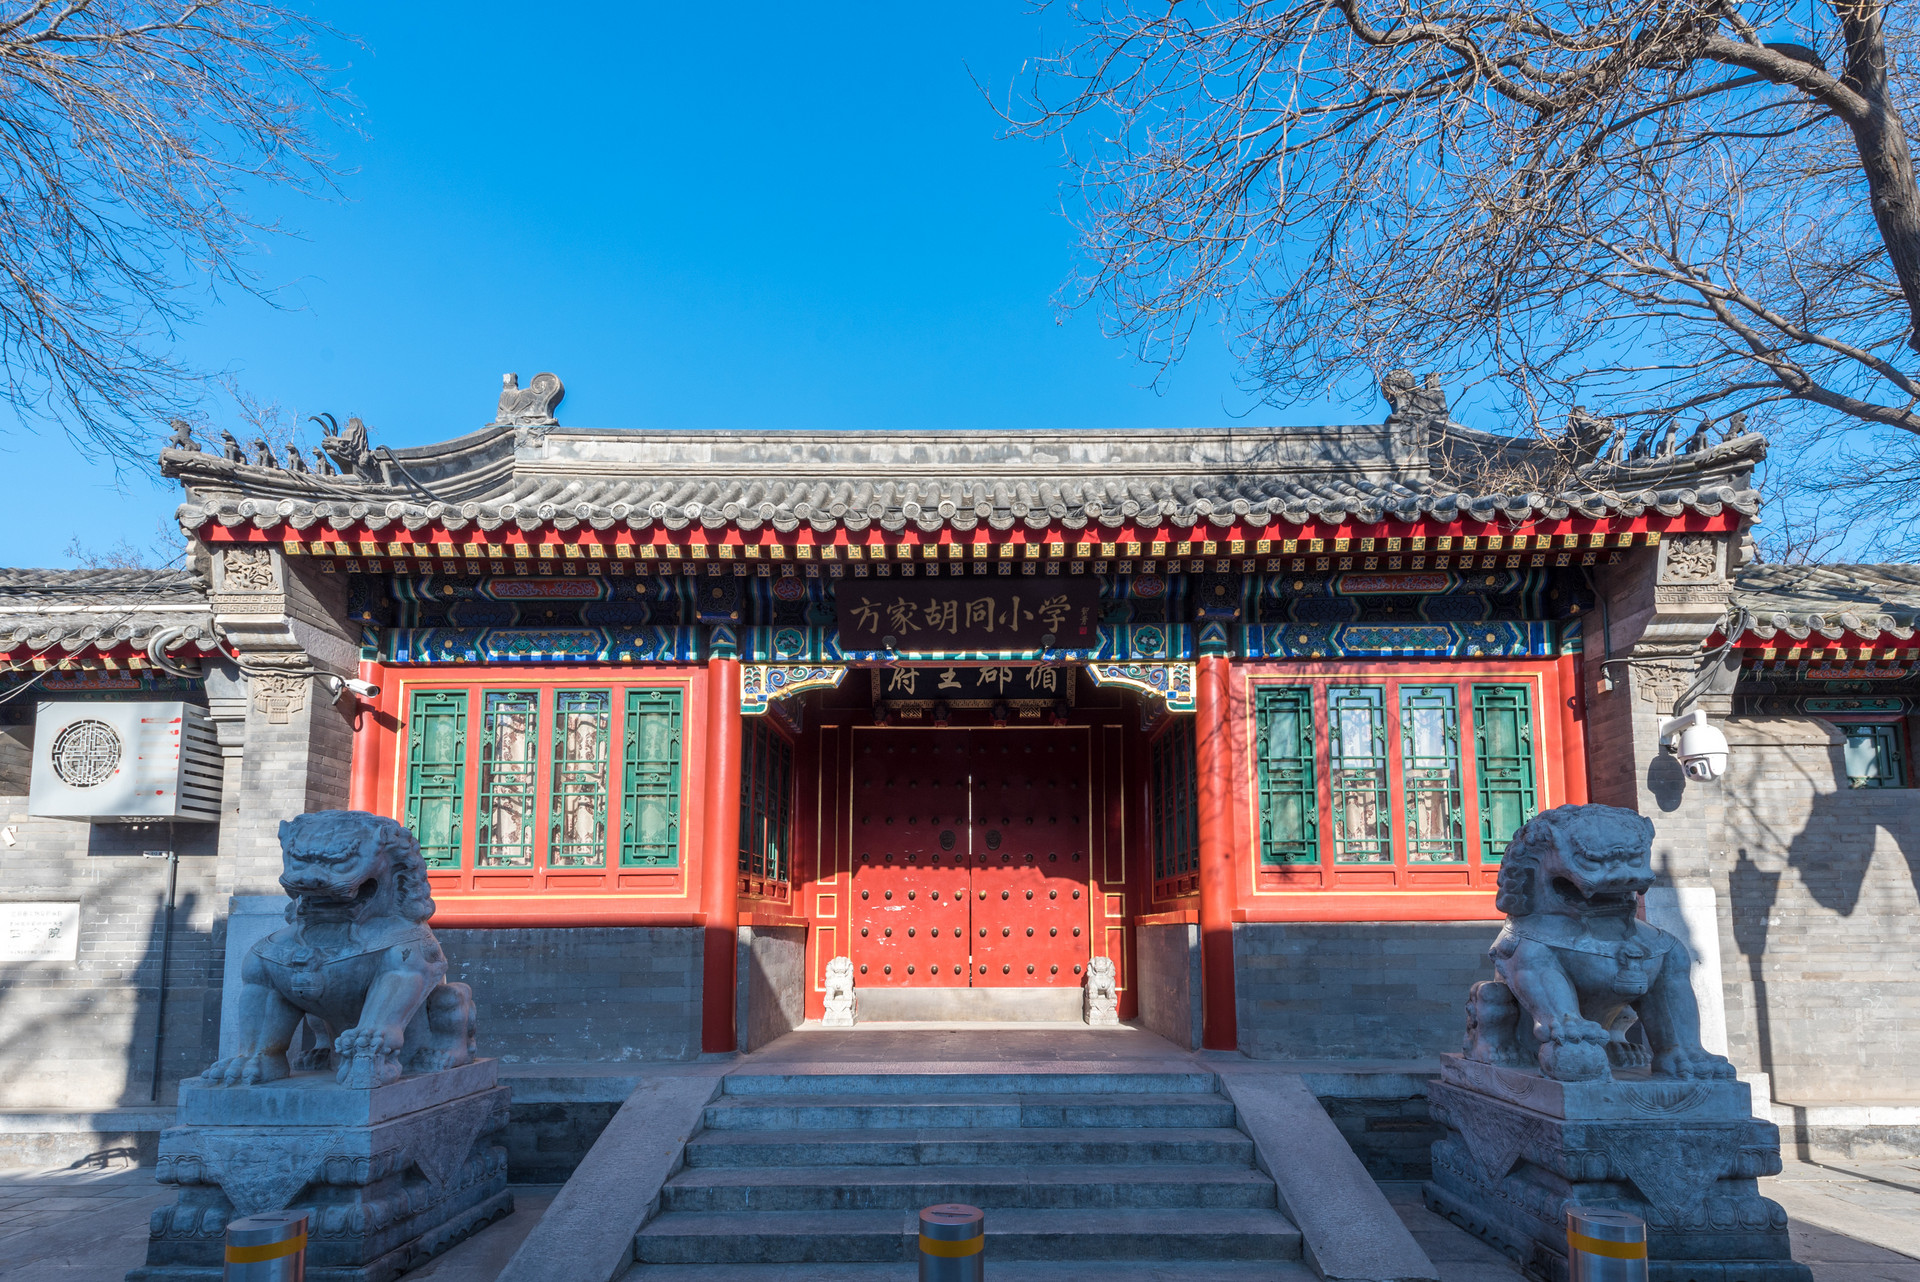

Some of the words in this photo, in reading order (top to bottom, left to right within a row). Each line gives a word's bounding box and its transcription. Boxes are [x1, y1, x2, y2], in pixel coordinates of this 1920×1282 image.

[851, 595, 1070, 634] 方家胡同小学
